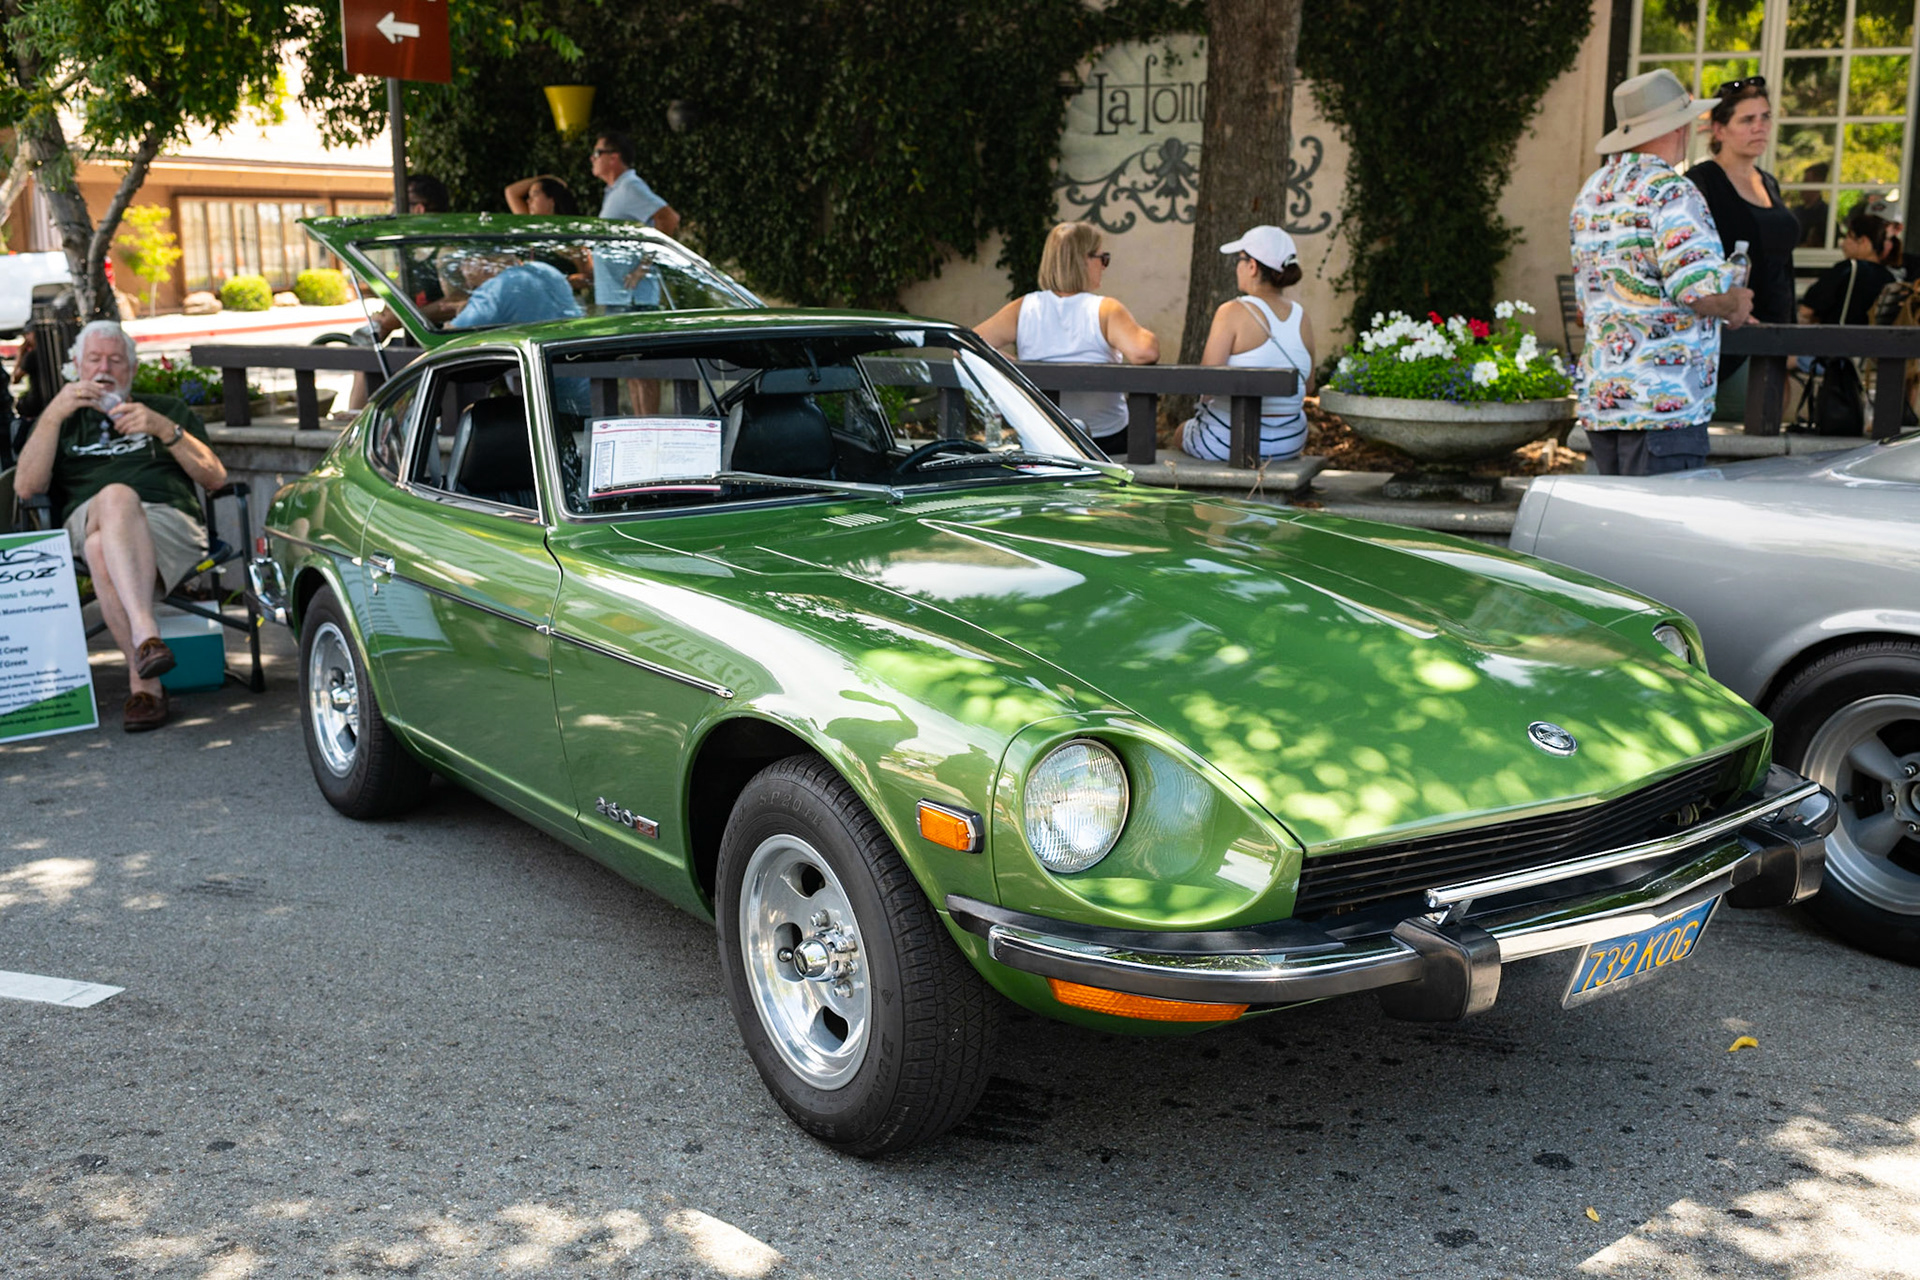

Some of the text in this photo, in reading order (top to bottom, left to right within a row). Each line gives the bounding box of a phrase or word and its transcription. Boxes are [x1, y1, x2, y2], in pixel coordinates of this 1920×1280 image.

[1094, 72, 1137, 136] La
[1581, 920, 1700, 992] 739 KOG
